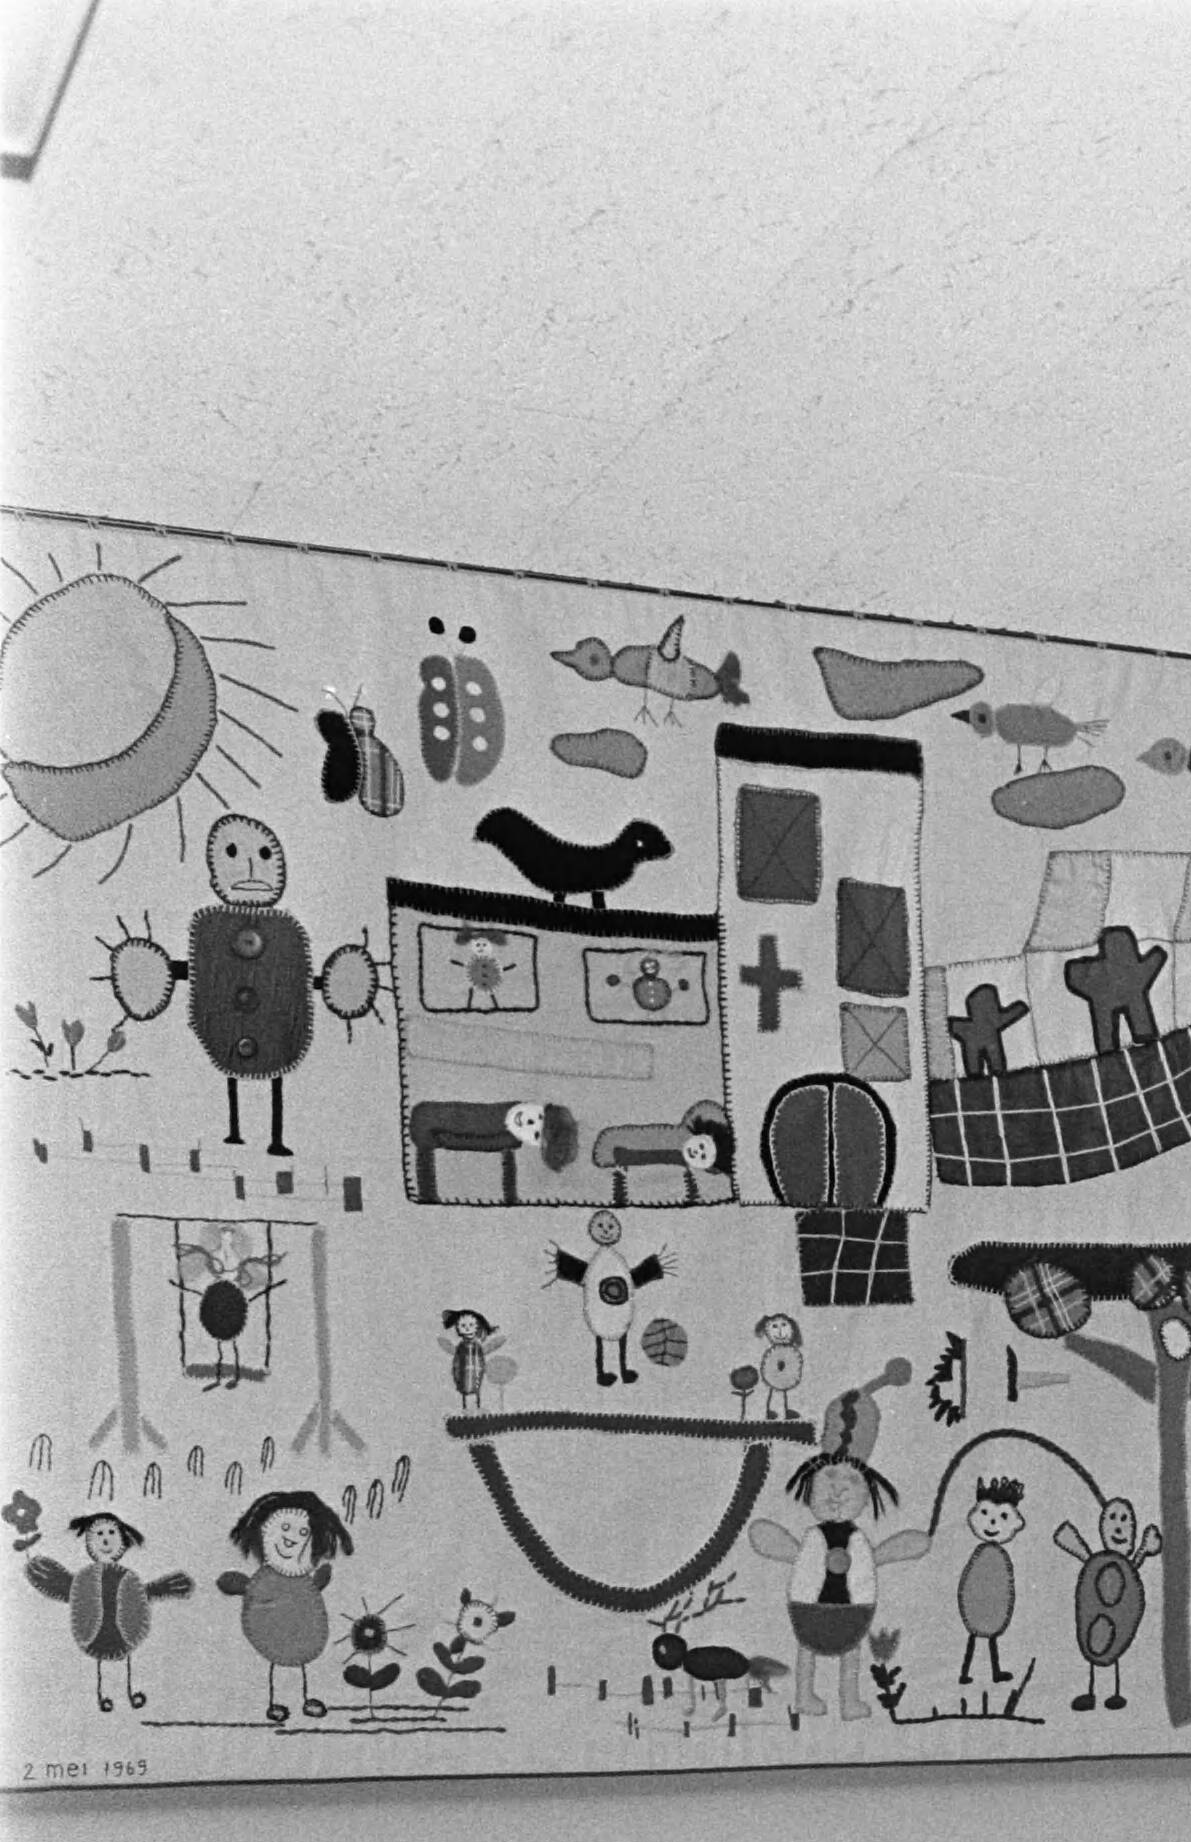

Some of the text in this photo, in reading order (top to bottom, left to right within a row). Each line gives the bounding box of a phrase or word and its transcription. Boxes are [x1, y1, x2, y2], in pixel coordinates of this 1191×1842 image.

[23, 1759, 148, 1780] 2 mei 1969
